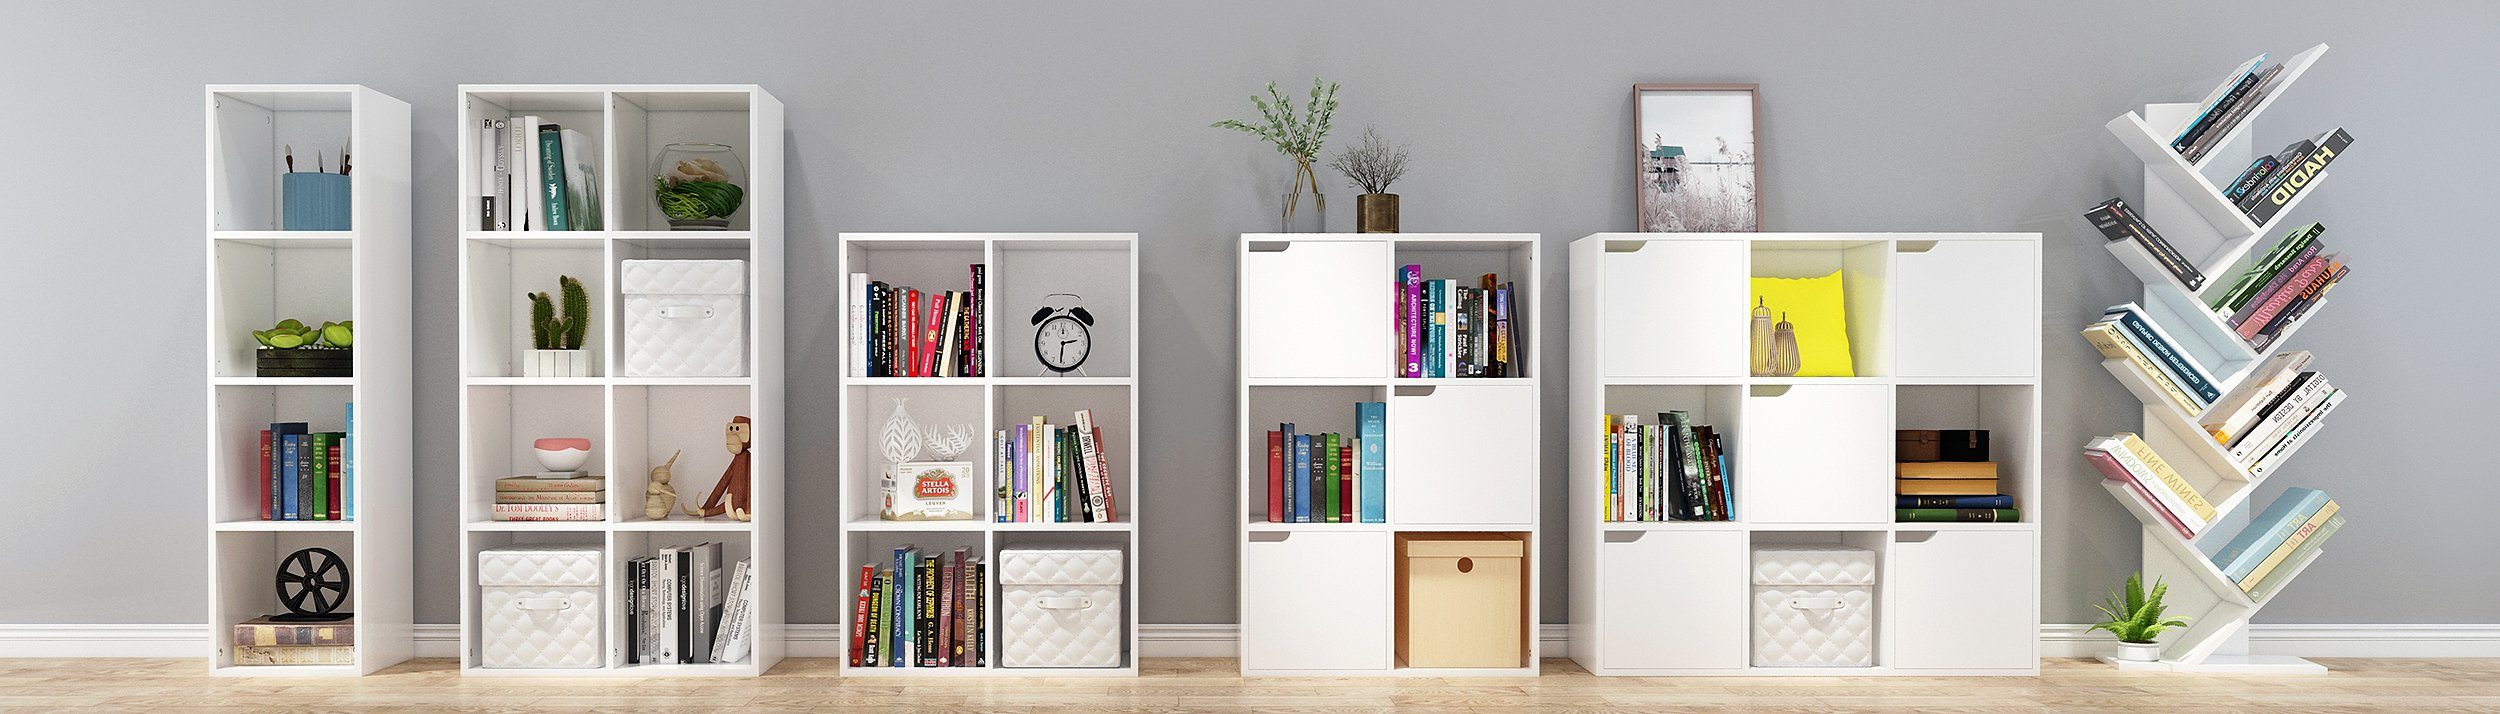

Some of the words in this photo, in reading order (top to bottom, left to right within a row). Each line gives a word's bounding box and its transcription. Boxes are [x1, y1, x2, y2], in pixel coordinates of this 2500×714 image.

[1408, 362, 1418, 372] 3
[1081, 435, 1092, 454] ORWELL
[1625, 438, 1630, 446] OF
[871, 592, 879, 612] DUNGEON
